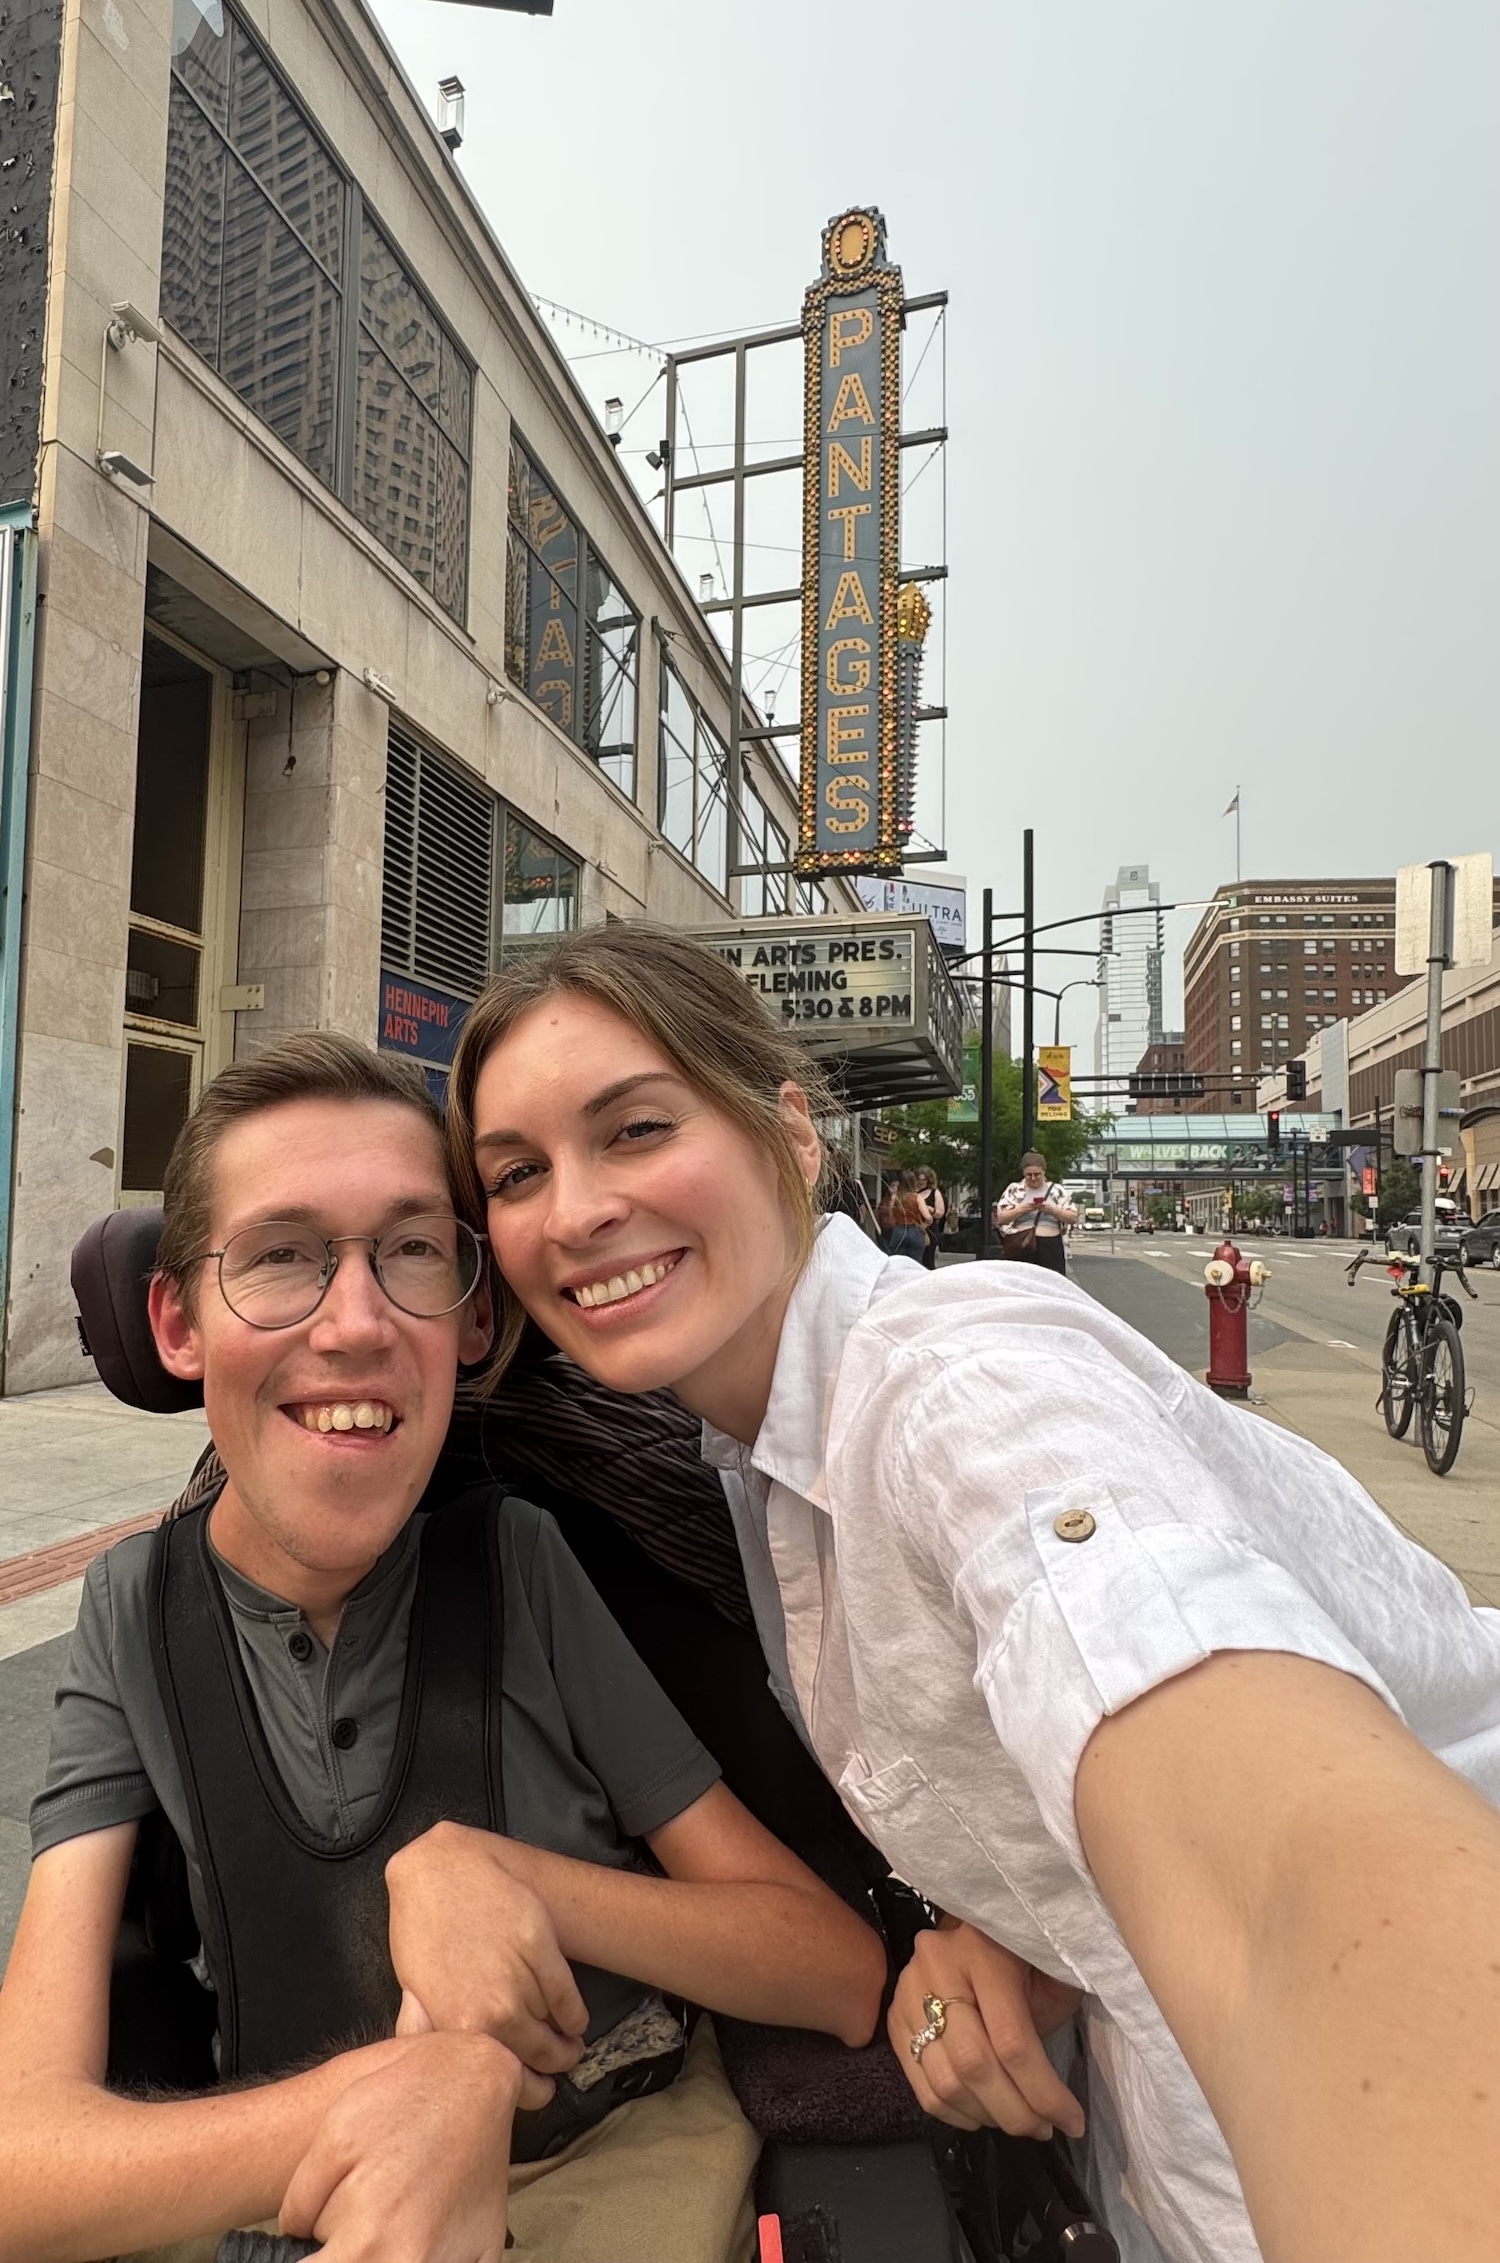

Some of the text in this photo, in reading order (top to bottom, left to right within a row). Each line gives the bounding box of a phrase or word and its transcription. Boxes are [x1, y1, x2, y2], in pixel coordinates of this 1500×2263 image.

[825, 308, 875, 834] PANTAGES
[1254, 895, 1359, 904] EMBASSY SUITES
[752, 944, 816, 967] ARTS
[829, 940, 902, 963] PRES.
[746, 970, 847, 993] FLEMING
[384, 984, 449, 1028] HENNEPIN
[781, 998, 833, 1019] 5:30
[838, 997, 854, 1018] &
[383, 1013, 418, 1046] ARTS
[1190, 1145, 1228, 1159] BACK
